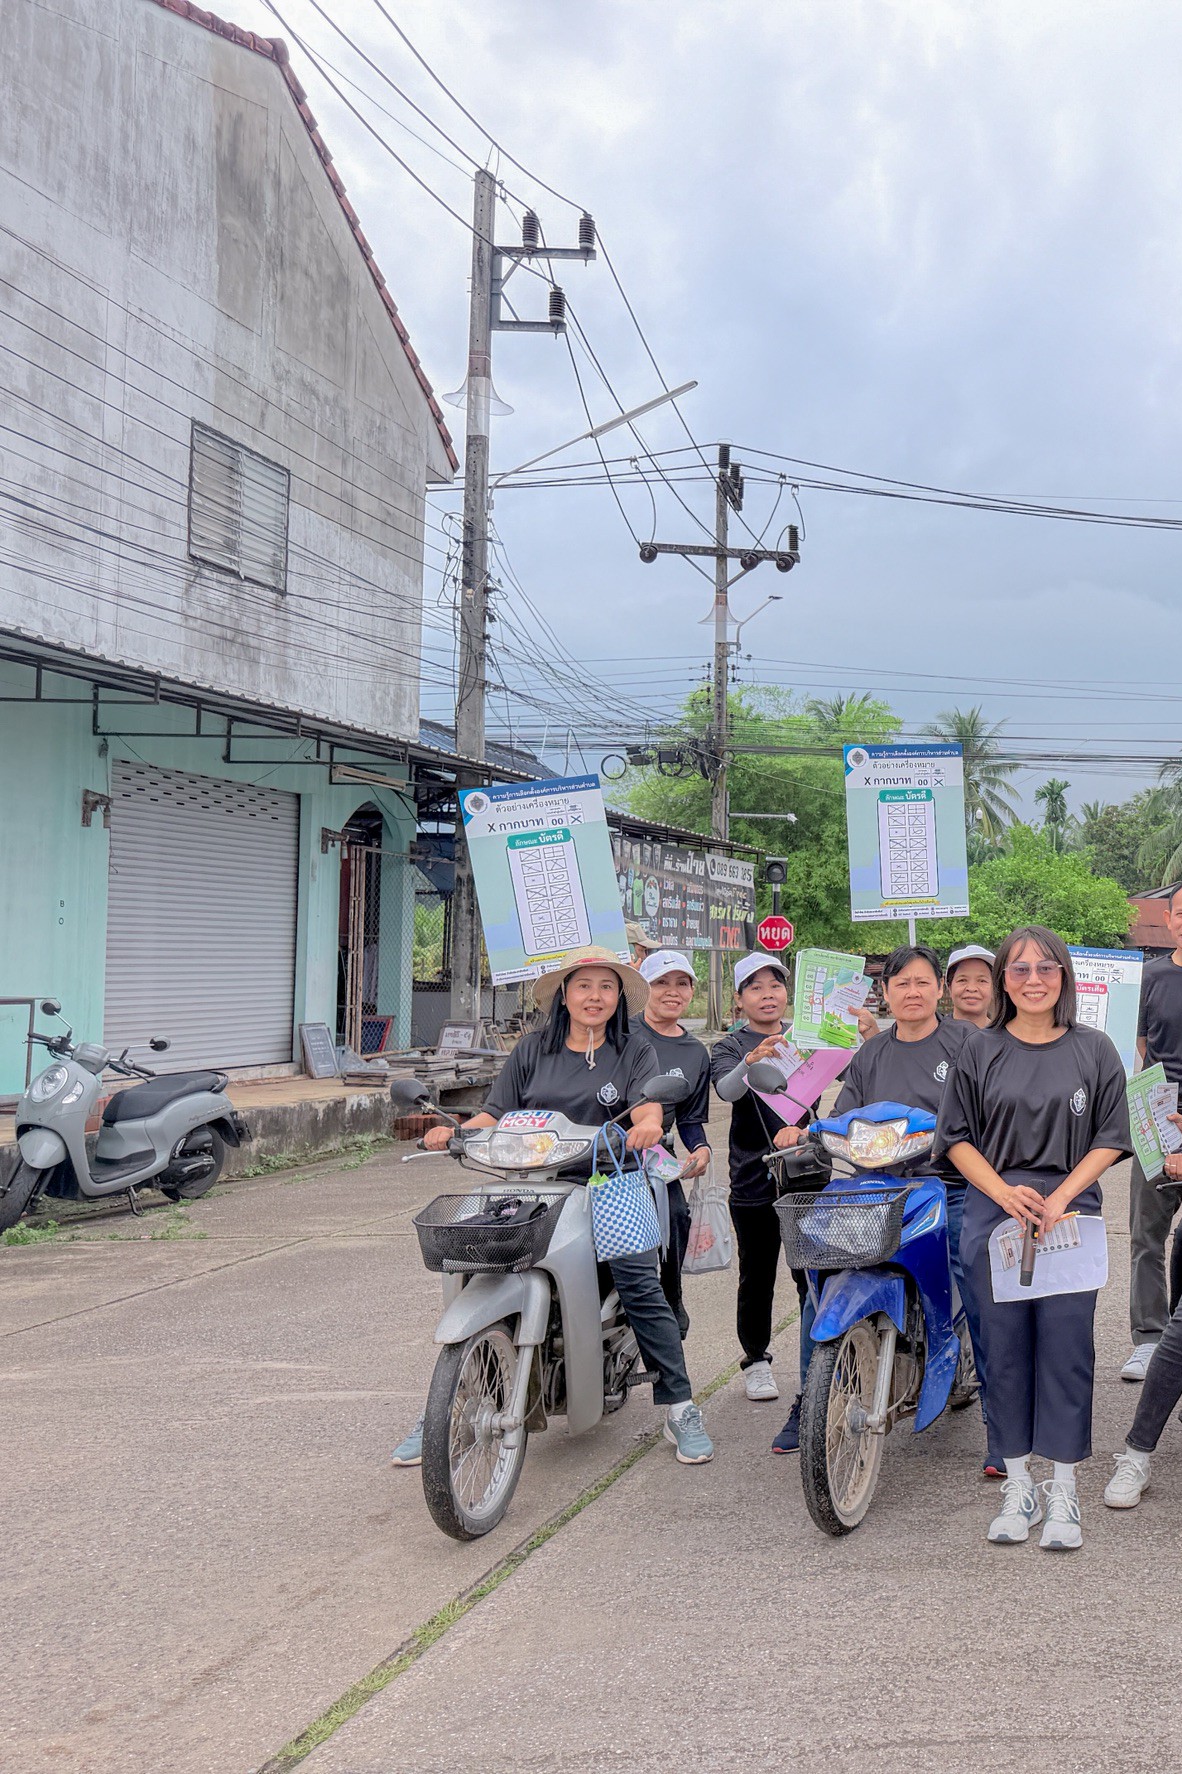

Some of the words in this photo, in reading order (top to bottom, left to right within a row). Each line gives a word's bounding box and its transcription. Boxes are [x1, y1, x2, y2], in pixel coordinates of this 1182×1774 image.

[872, 760, 936, 769] ตัวอย่างเครื่องหมาย
[873, 777, 912, 786] กากบาท
[905, 790, 927, 800] บัตรดี
[495, 797, 570, 813] ตัวอย่างเครื่องหมาย
[499, 817, 544, 831] กากบาท
[538, 831, 564, 843] บัตรดี
[760, 927, 790, 947] หยุด
[501, 1118, 543, 1127] MOLY
